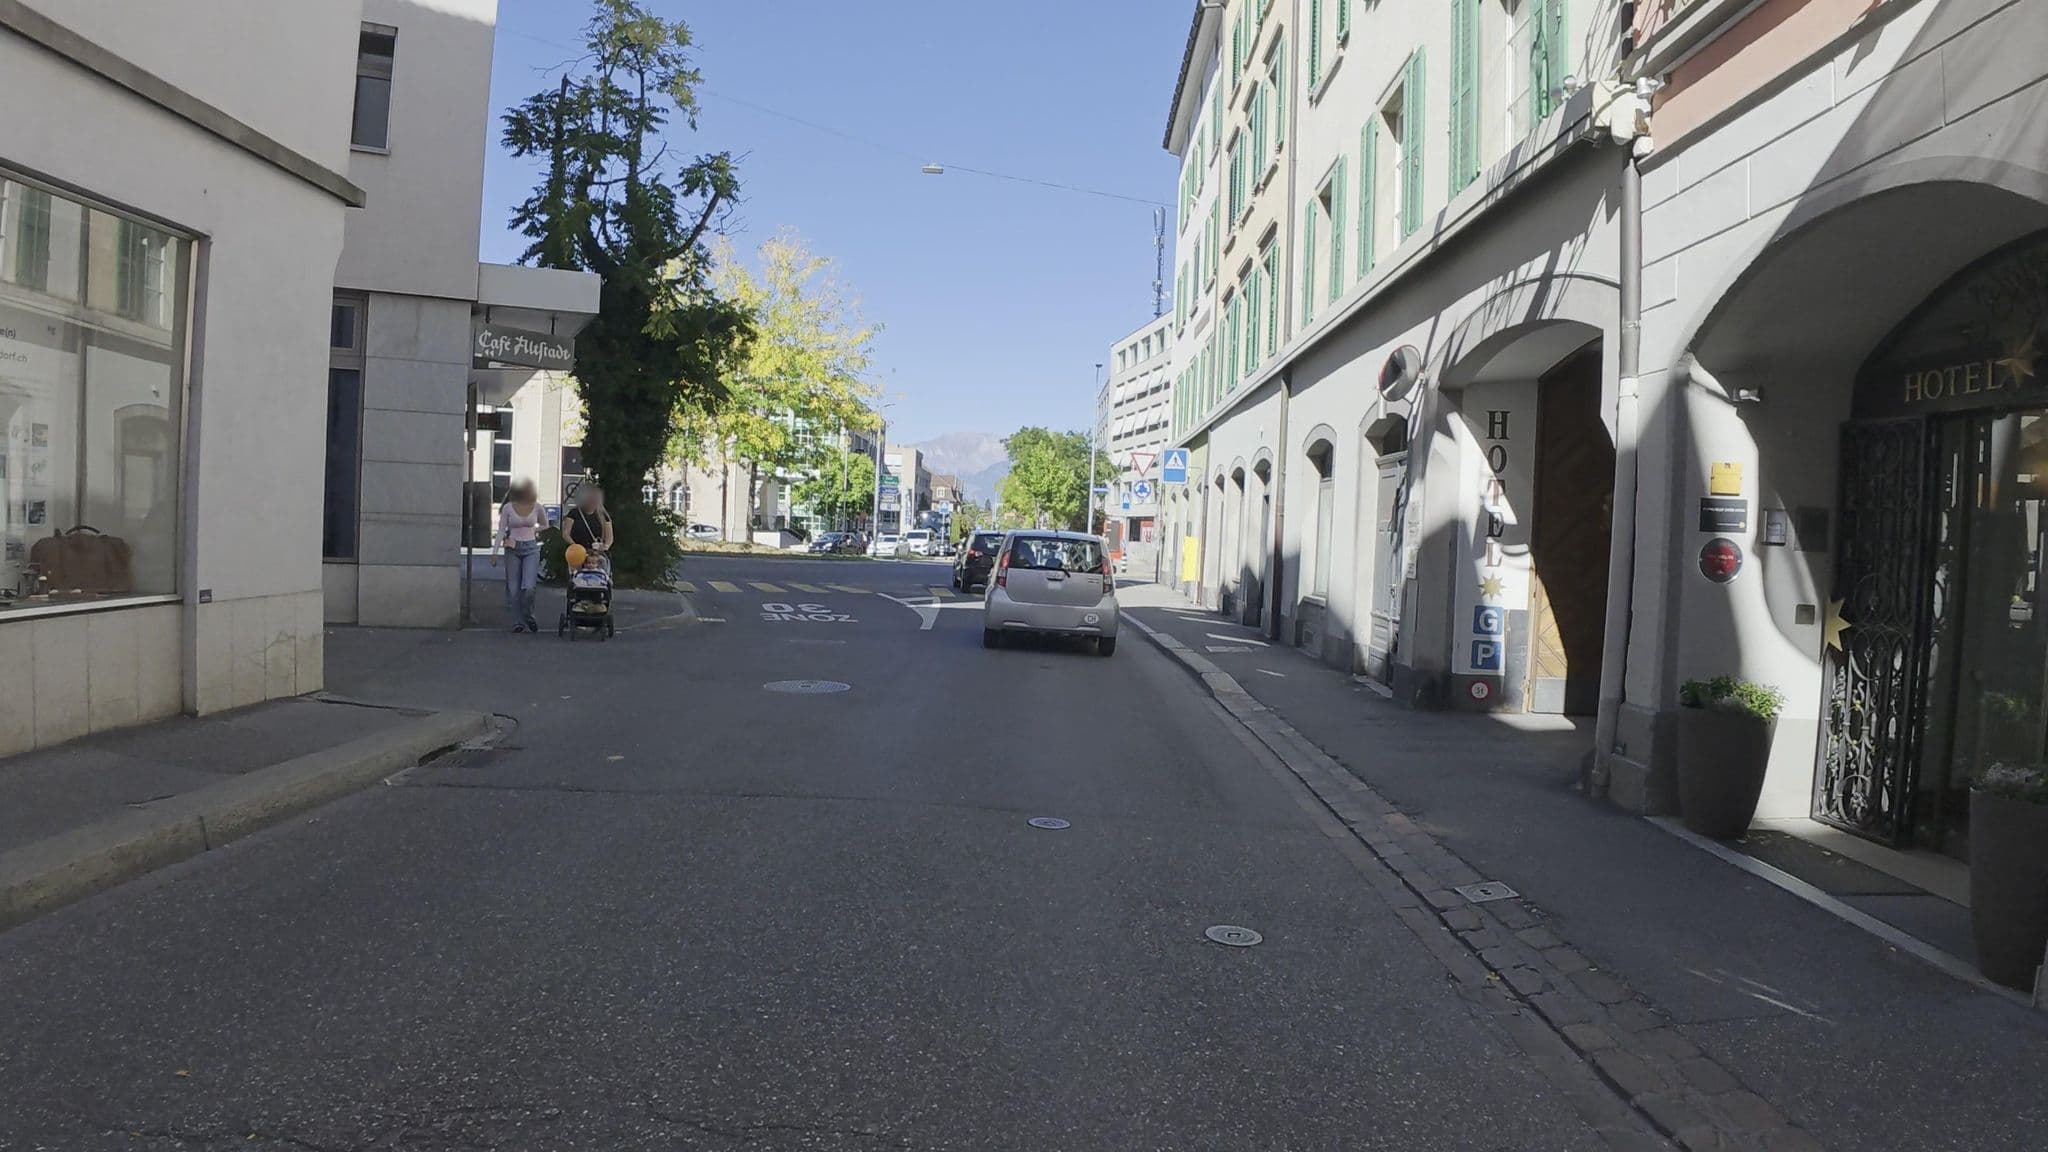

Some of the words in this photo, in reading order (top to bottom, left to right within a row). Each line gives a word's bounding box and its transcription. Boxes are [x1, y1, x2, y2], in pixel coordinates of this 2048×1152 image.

[478, 330, 511, 356] Café
[1904, 360, 2003, 402] HOTEL
[1485, 410, 1510, 568] HOTEL
[760, 613, 859, 622] ZONE
[762, 603, 832, 613] 30
[1479, 610, 1499, 632] G
[1477, 644, 1494, 666] P
